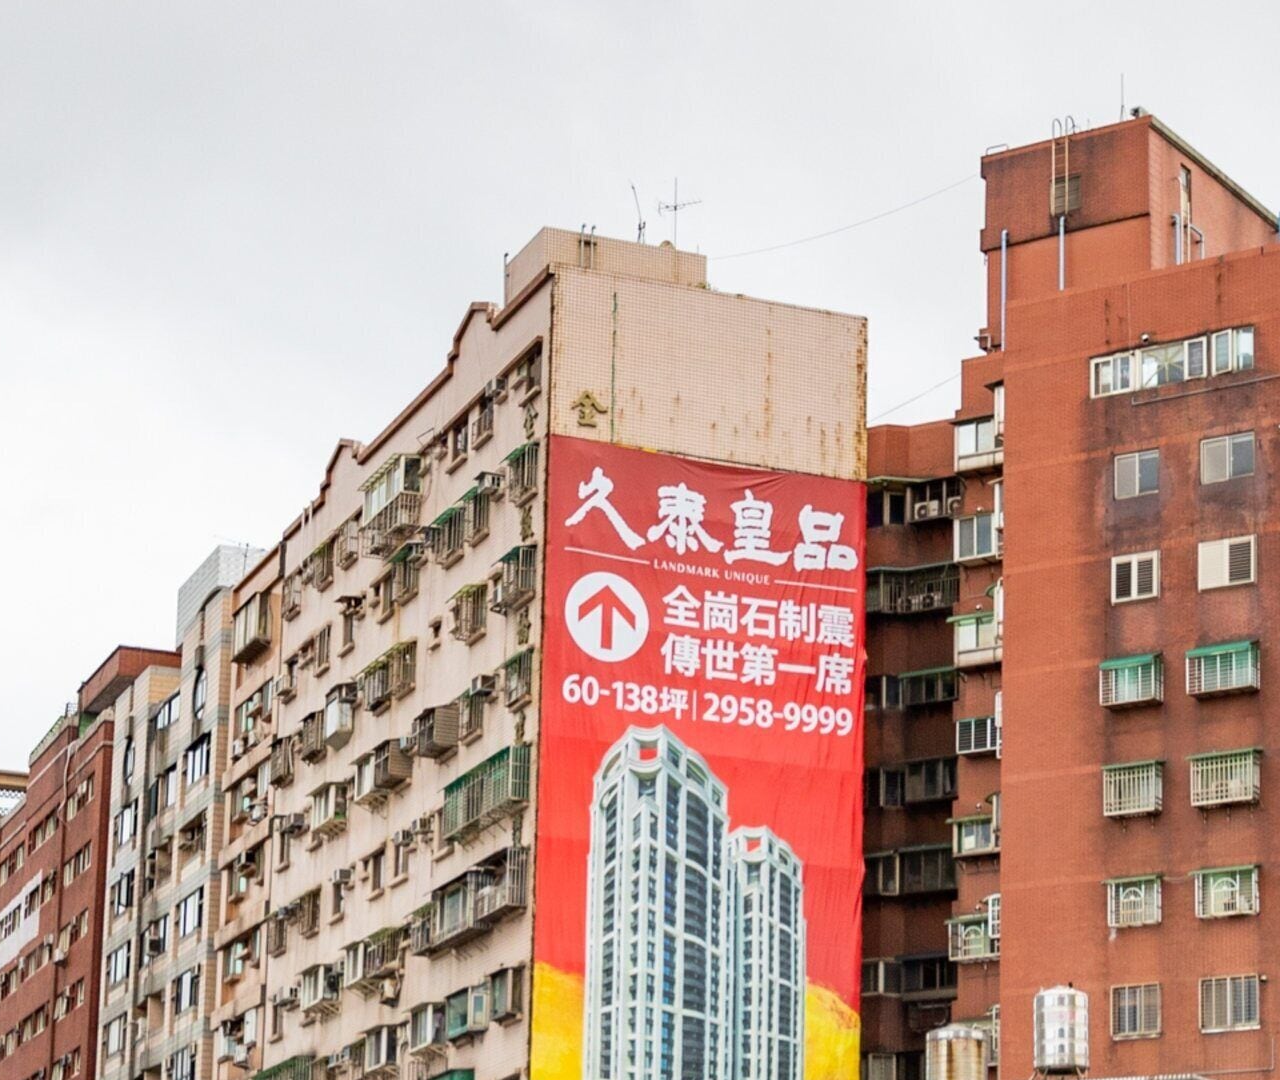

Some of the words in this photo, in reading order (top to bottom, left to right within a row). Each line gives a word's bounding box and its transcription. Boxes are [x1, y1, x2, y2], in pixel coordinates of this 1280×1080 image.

[565, 466, 858, 572] 久泰皇品
[654, 558, 719, 579] LANDMARK
[724, 569, 770, 585] UNIQUE
[662, 584, 855, 649] 全崗石制震
[661, 632, 854, 697] 傳世第一席
